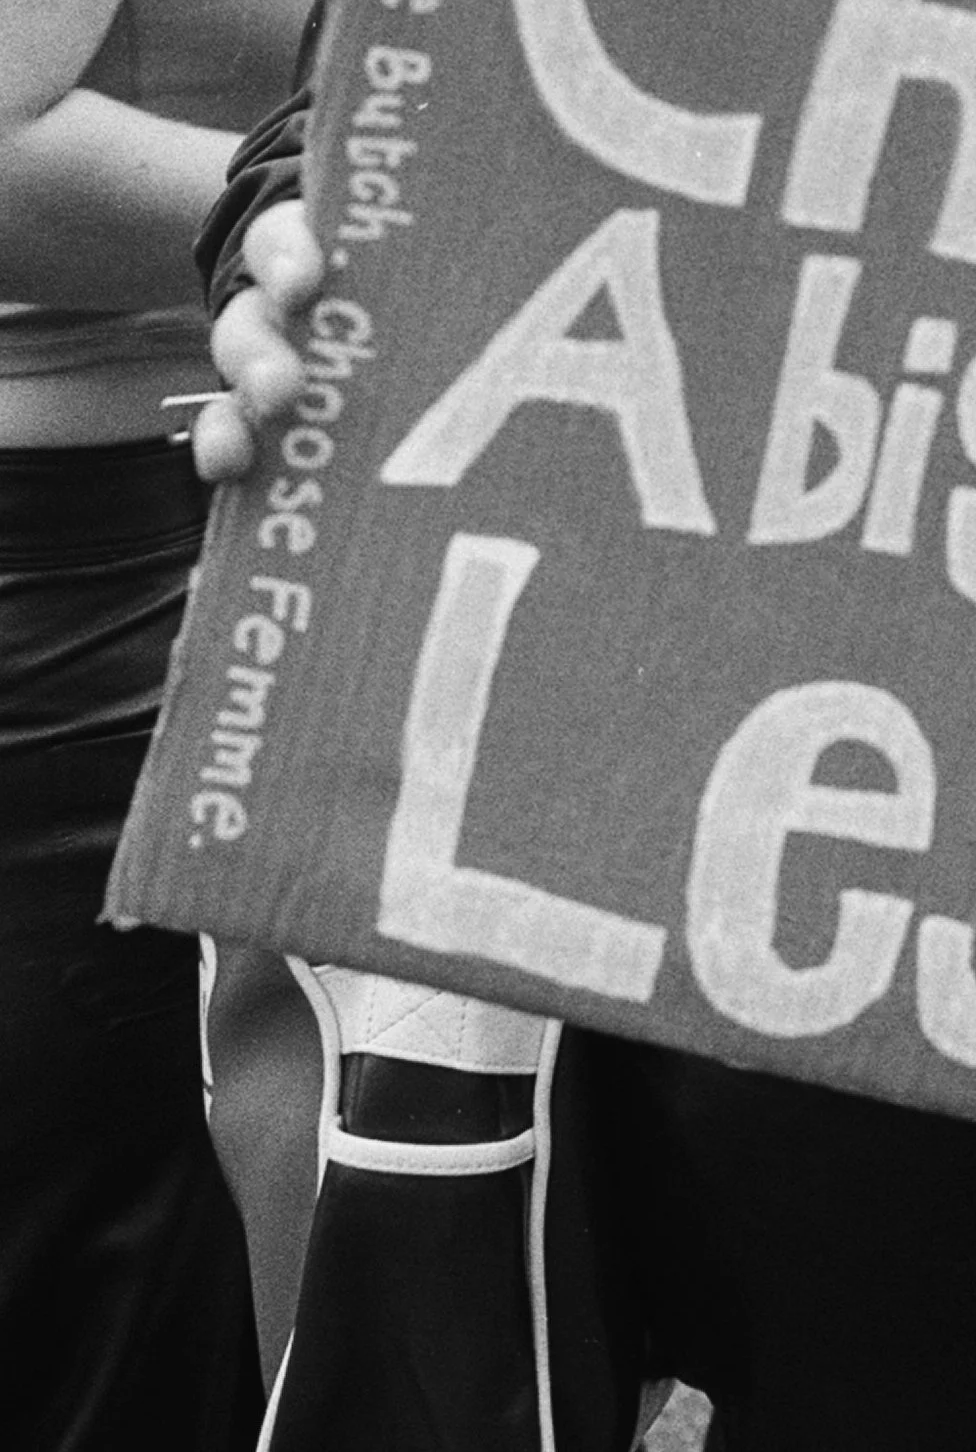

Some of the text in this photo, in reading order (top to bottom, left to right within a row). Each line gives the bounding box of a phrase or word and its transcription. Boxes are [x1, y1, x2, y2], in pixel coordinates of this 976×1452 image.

[257, 298, 377, 554] Choose
[380, 208, 717, 537] A
[189, 575, 313, 848] Femme.
